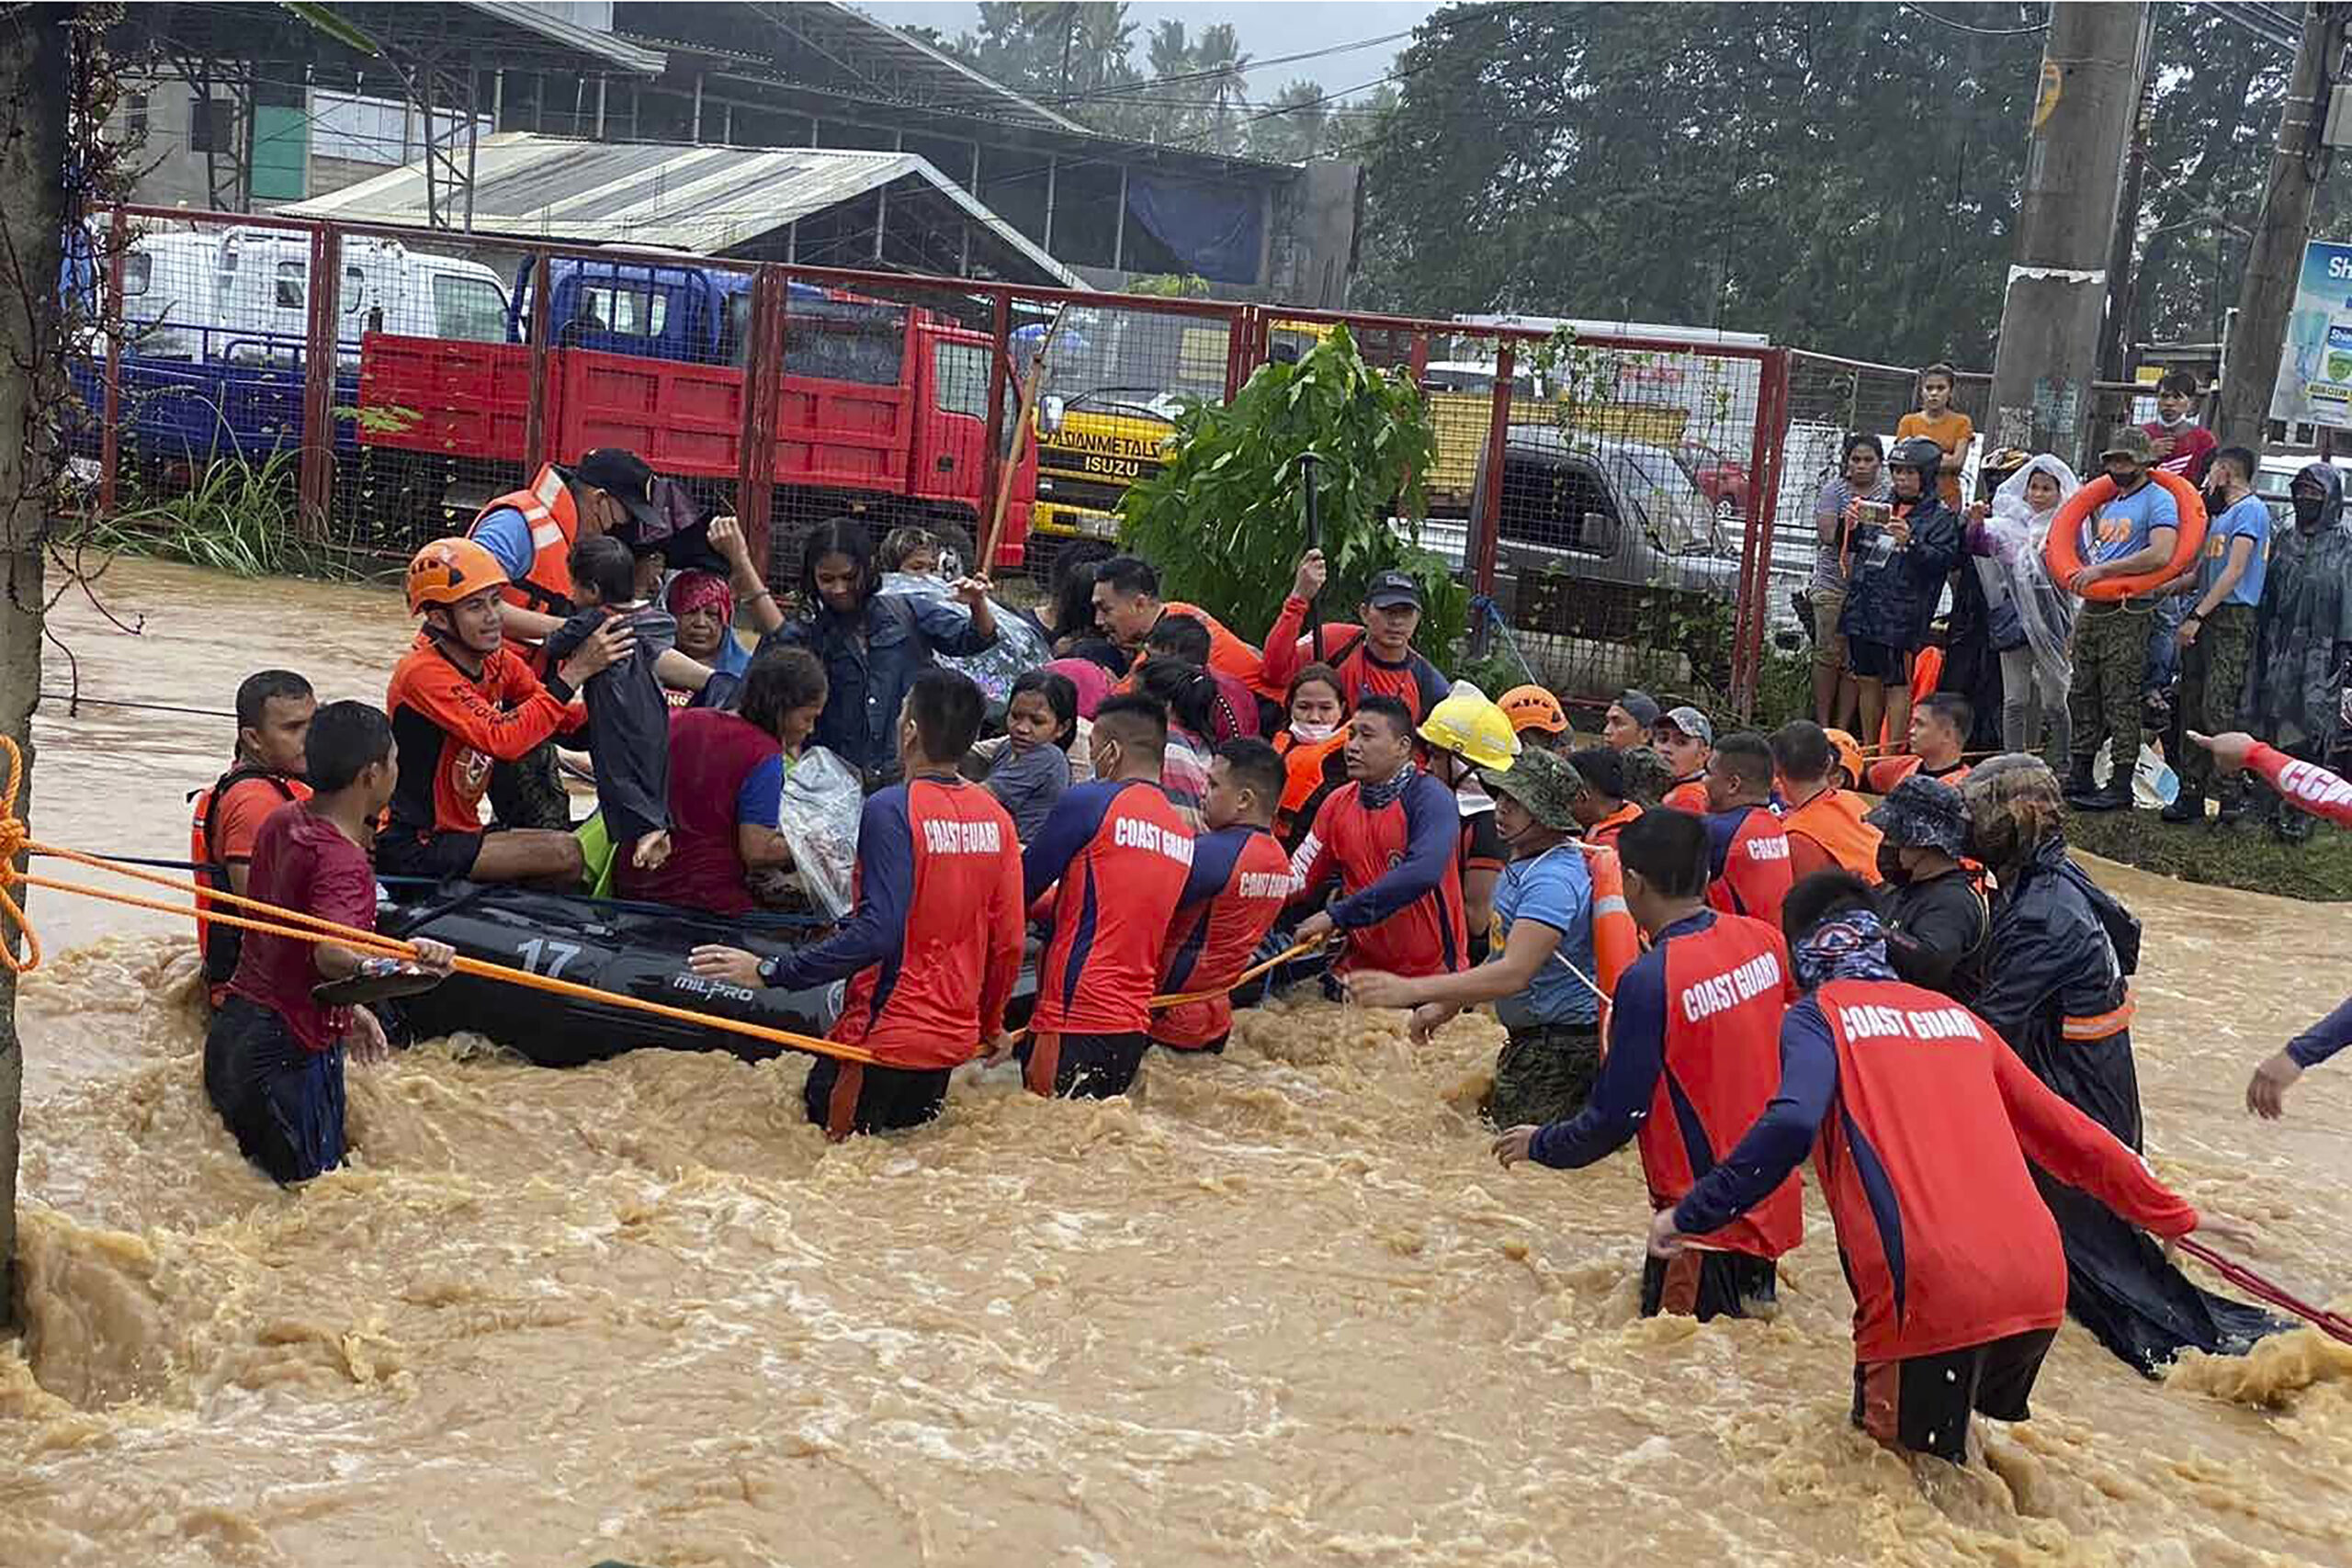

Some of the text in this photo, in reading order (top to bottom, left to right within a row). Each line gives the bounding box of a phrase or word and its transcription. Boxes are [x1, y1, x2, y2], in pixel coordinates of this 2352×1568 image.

[1085, 456, 1139, 477] ISUZU
[922, 818, 1001, 853] COAST GUARD
[1114, 817, 1162, 852] COAST
[517, 939, 582, 977] 17
[673, 974, 754, 1001] MILPRO
[1682, 952, 1781, 1022] COAST GUARD
[1839, 1005, 1911, 1043] COAST
